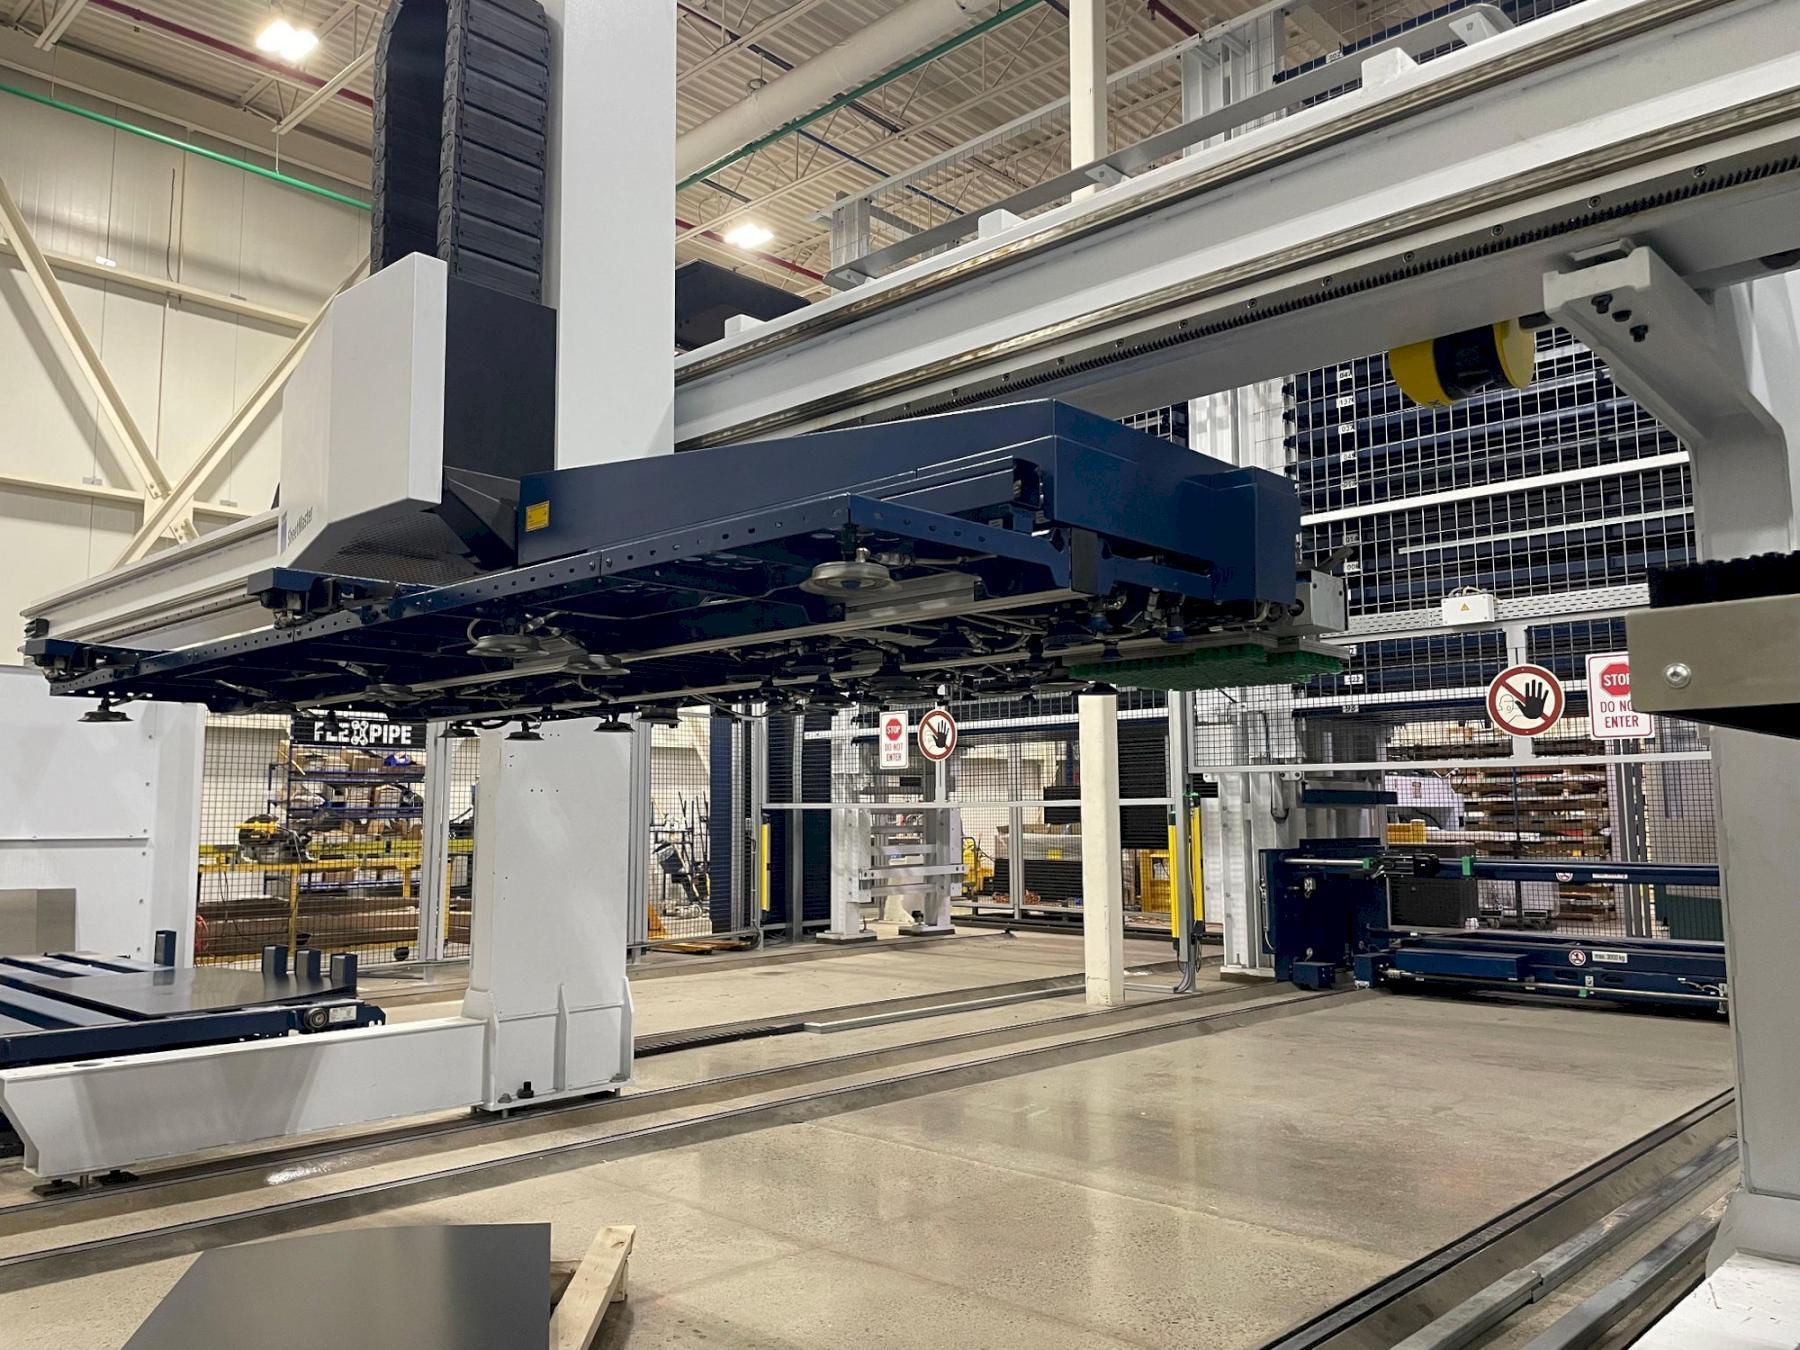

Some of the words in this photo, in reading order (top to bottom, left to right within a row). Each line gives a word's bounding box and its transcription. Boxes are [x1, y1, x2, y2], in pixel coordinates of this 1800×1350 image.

[1600, 701, 1615, 712] DO
[1620, 700, 1632, 711] NO
[1605, 715, 1639, 728] ENTER
[887, 725, 901, 734] STOP
[893, 743, 903, 751] NOT
[887, 753, 901, 762] ENTER
